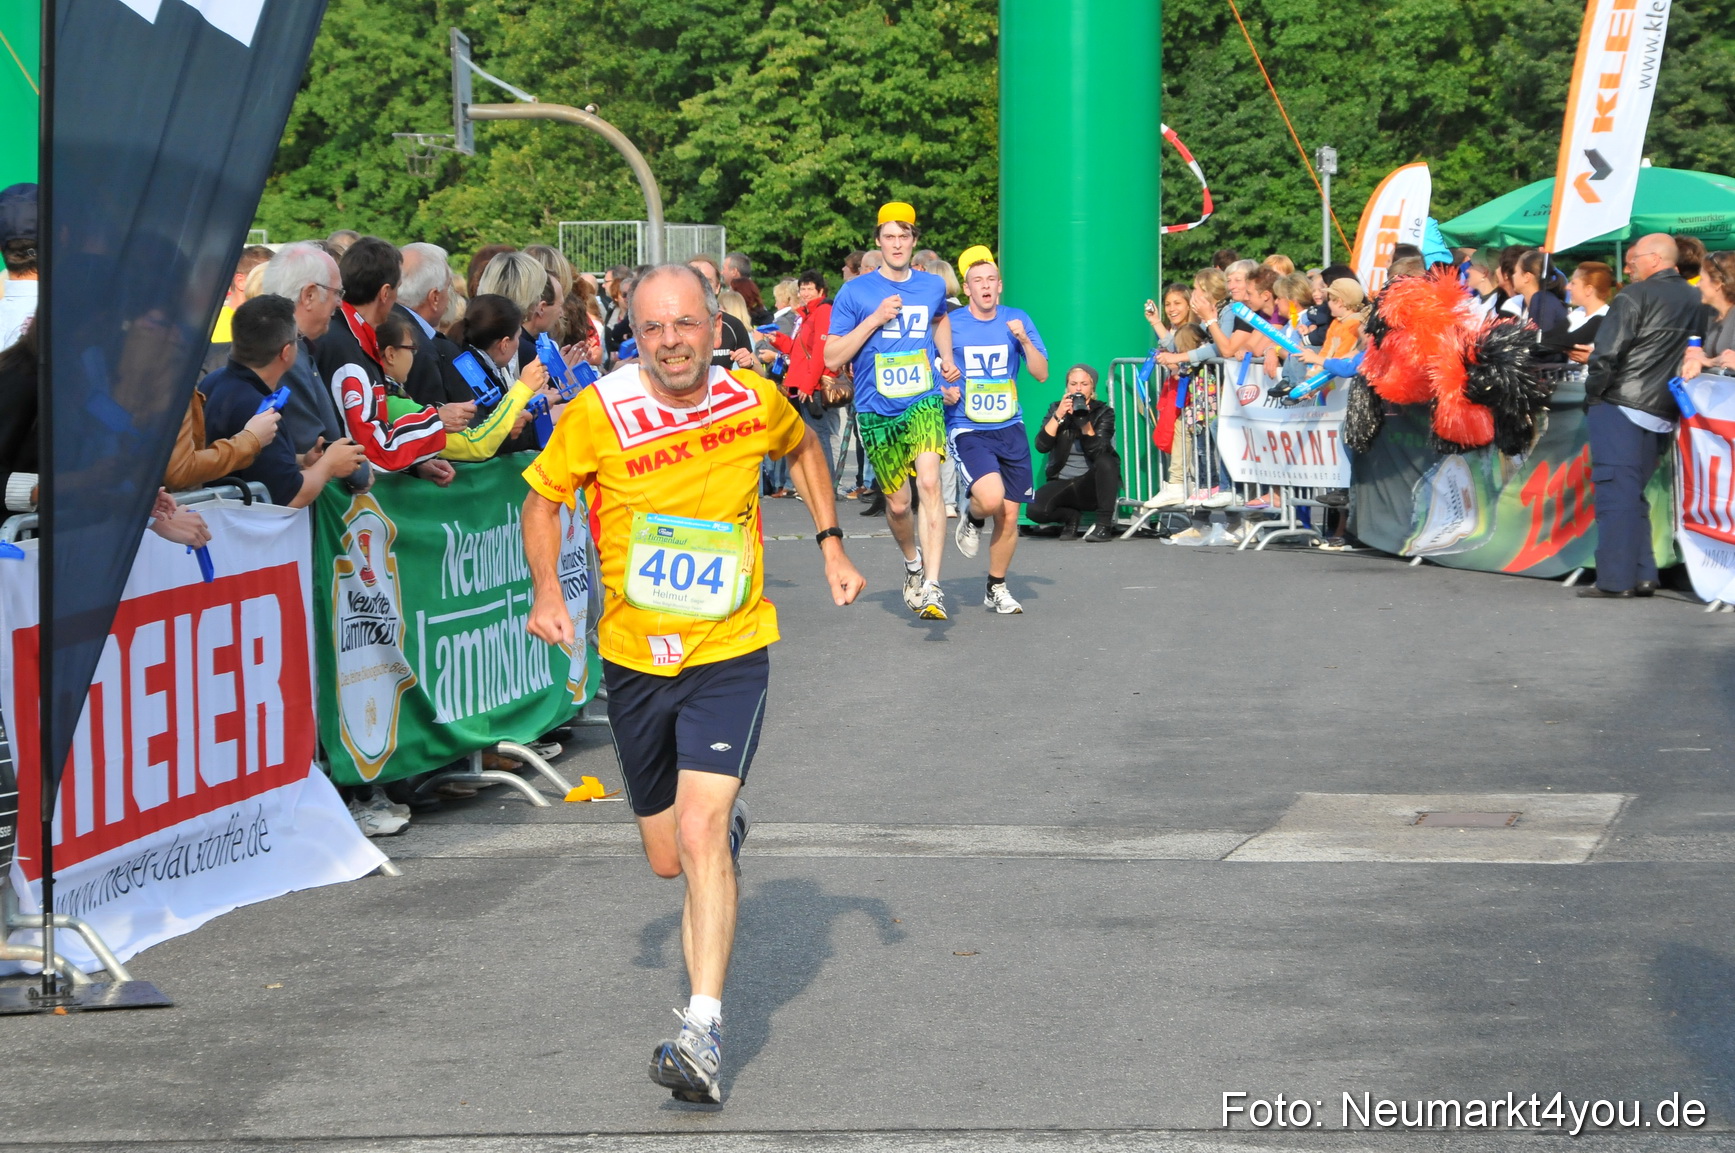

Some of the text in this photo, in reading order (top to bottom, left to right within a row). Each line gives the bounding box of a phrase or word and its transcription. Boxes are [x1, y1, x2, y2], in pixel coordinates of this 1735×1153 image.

[1678, 213, 1726, 224] Neumarkter
[883, 365, 921, 387] 904
[972, 393, 1007, 411] 905
[625, 417, 766, 478] MAX BÖGL
[1241, 425, 1338, 466] XL-PRINT
[648, 532, 688, 545] firmenlauf
[639, 549, 724, 594] 404
[653, 588, 688, 602] Helmut
